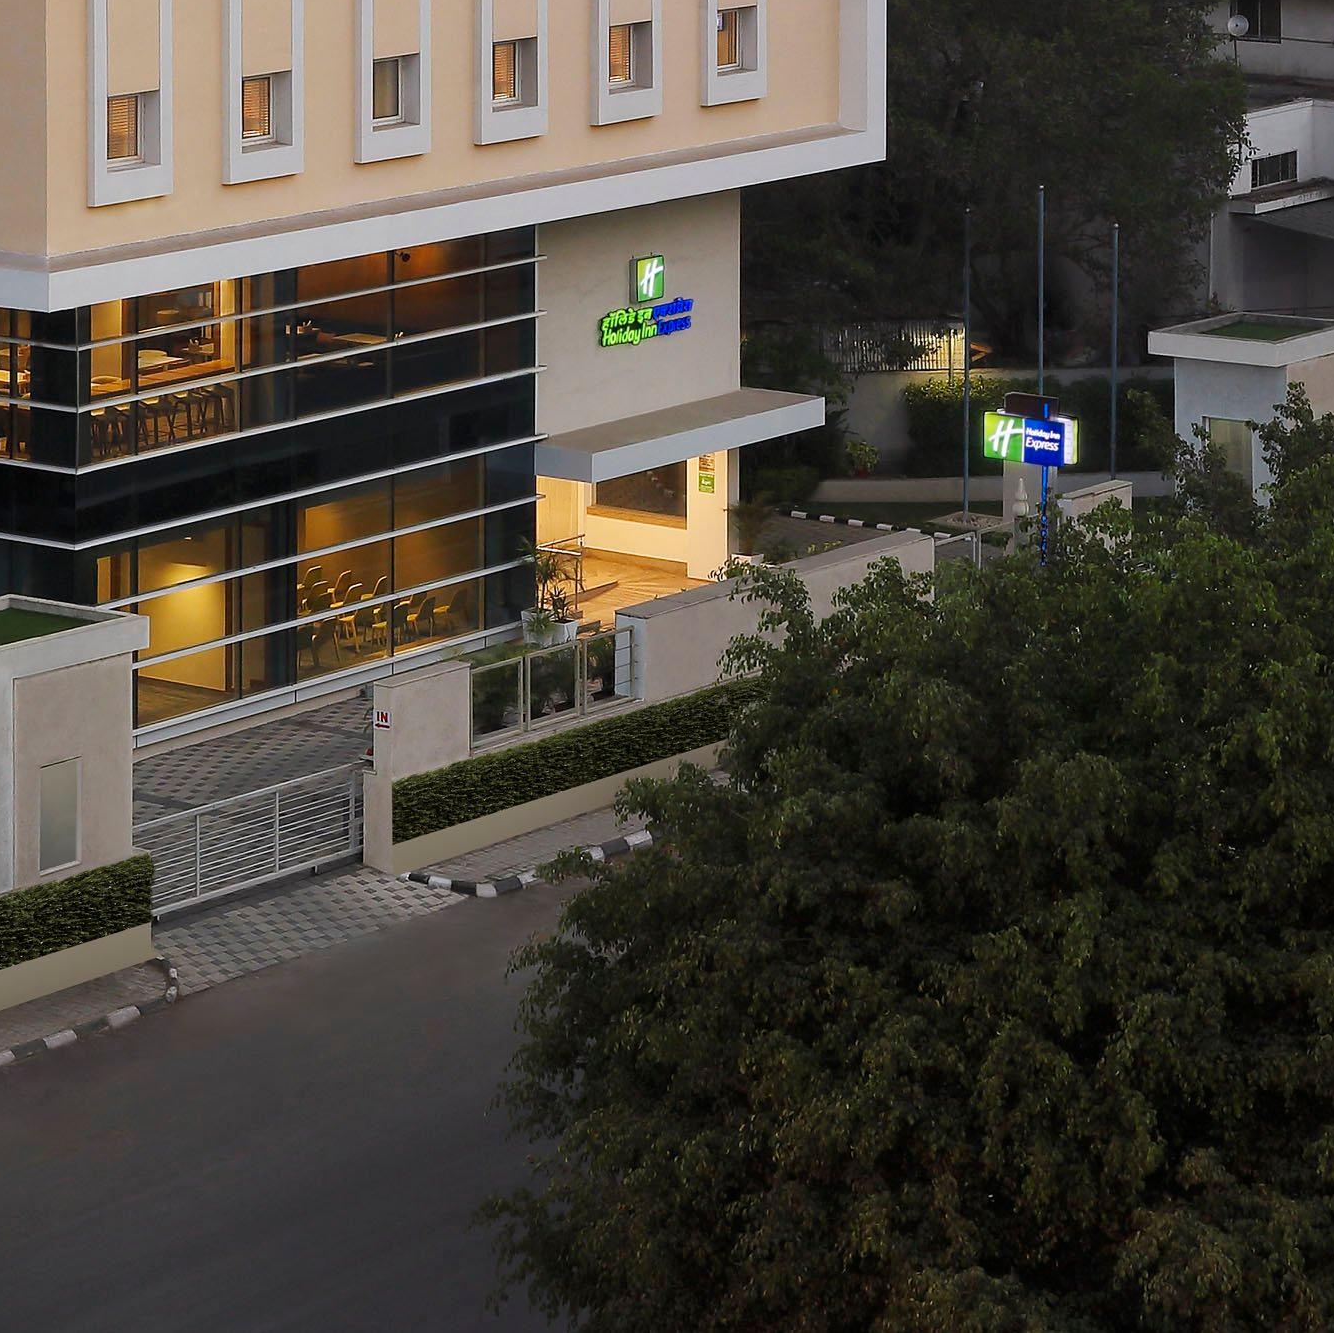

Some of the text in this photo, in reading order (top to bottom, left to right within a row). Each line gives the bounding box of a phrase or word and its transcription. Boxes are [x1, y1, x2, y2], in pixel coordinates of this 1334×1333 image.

[602, 316, 691, 346] Holiday Inn Express
[1026, 427, 1061, 440] Holiday Inn
[1026, 436, 1060, 452] Express
[377, 711, 388, 722] IN
